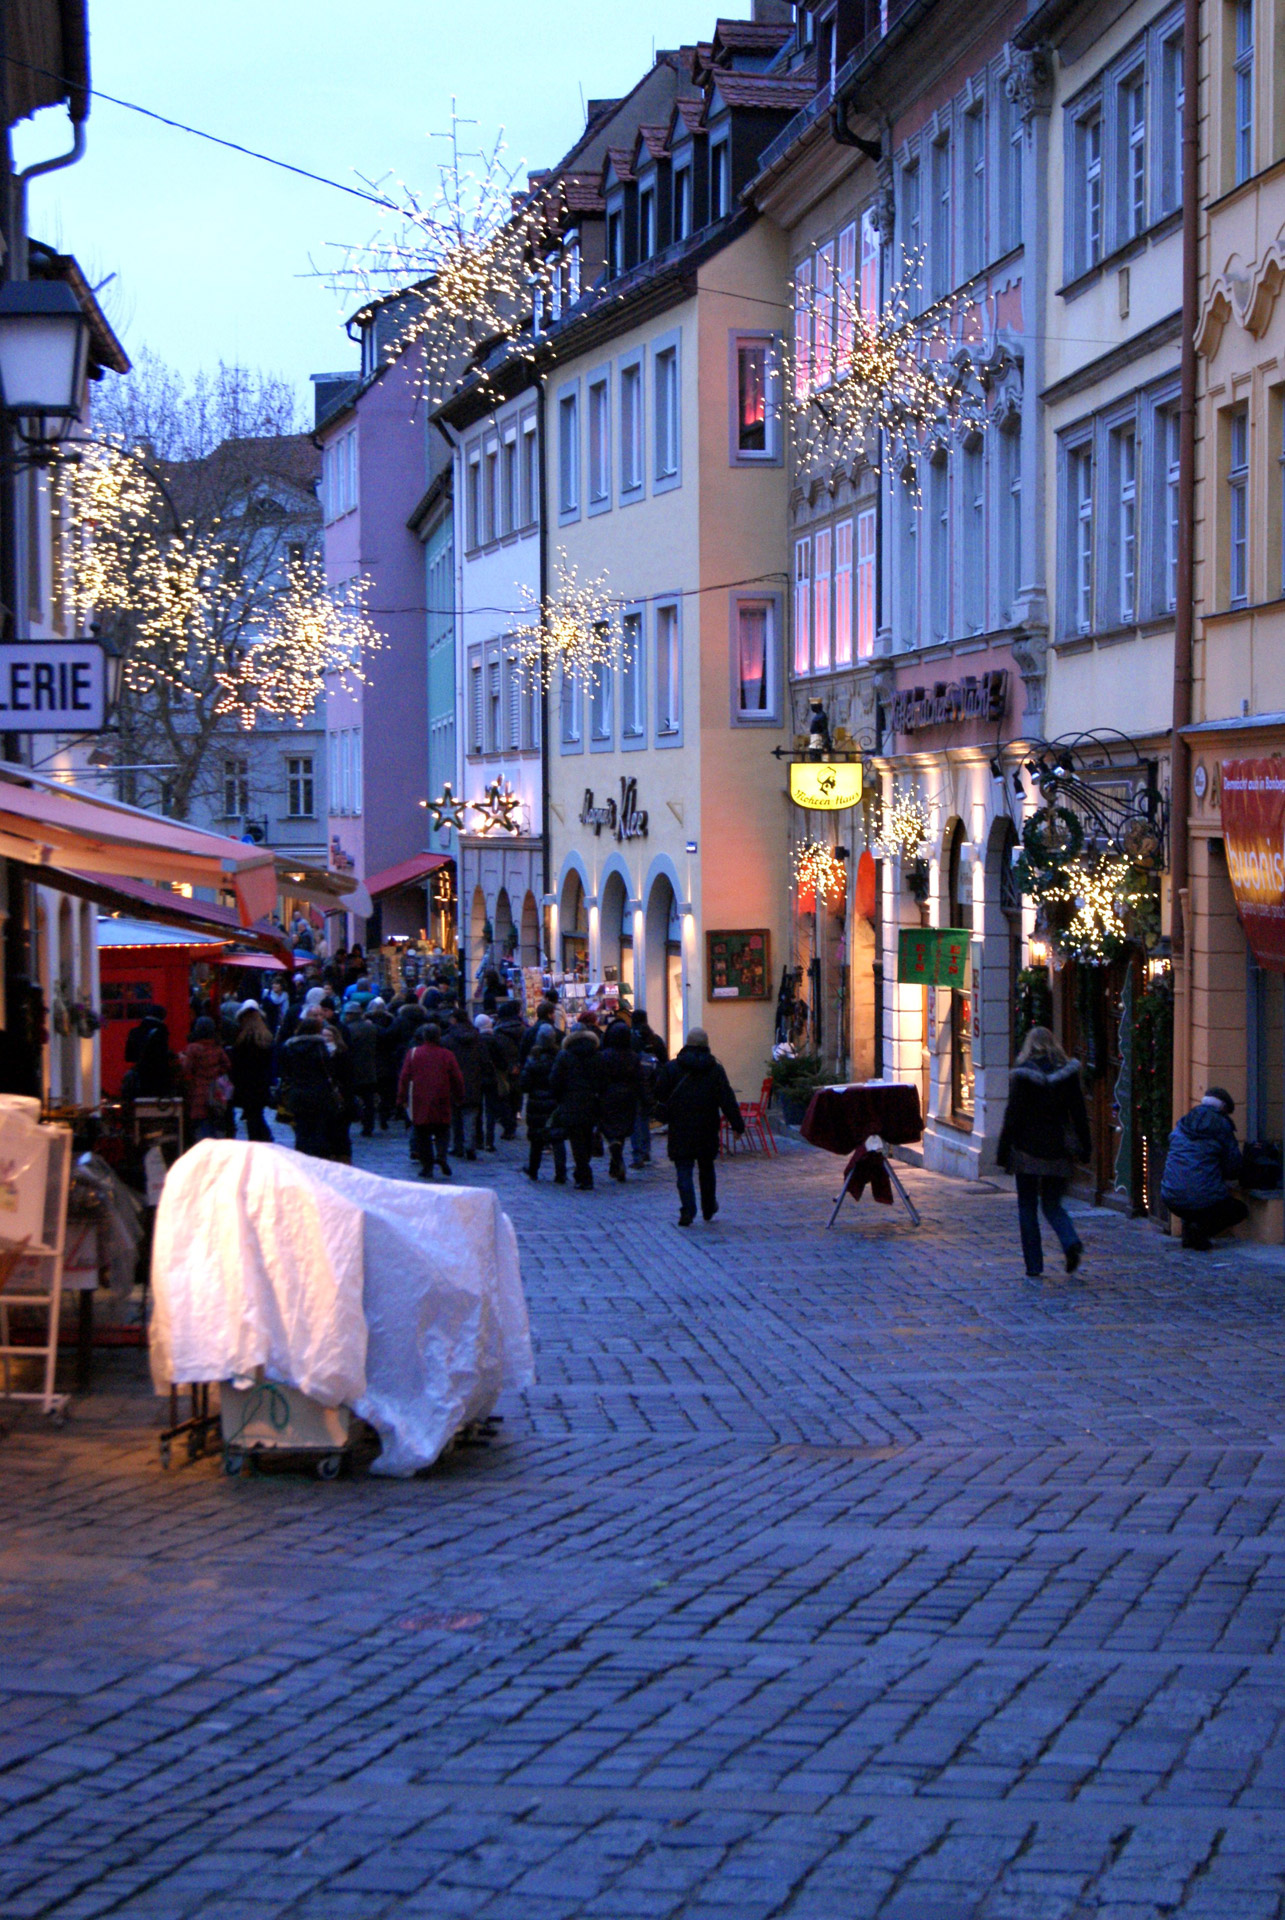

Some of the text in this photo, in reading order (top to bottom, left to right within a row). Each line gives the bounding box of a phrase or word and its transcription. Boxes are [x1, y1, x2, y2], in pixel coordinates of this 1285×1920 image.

[612, 775, 649, 842] Klee
[1226, 832, 1285, 893] buonis
[972, 968, 980, 1038] EIS
